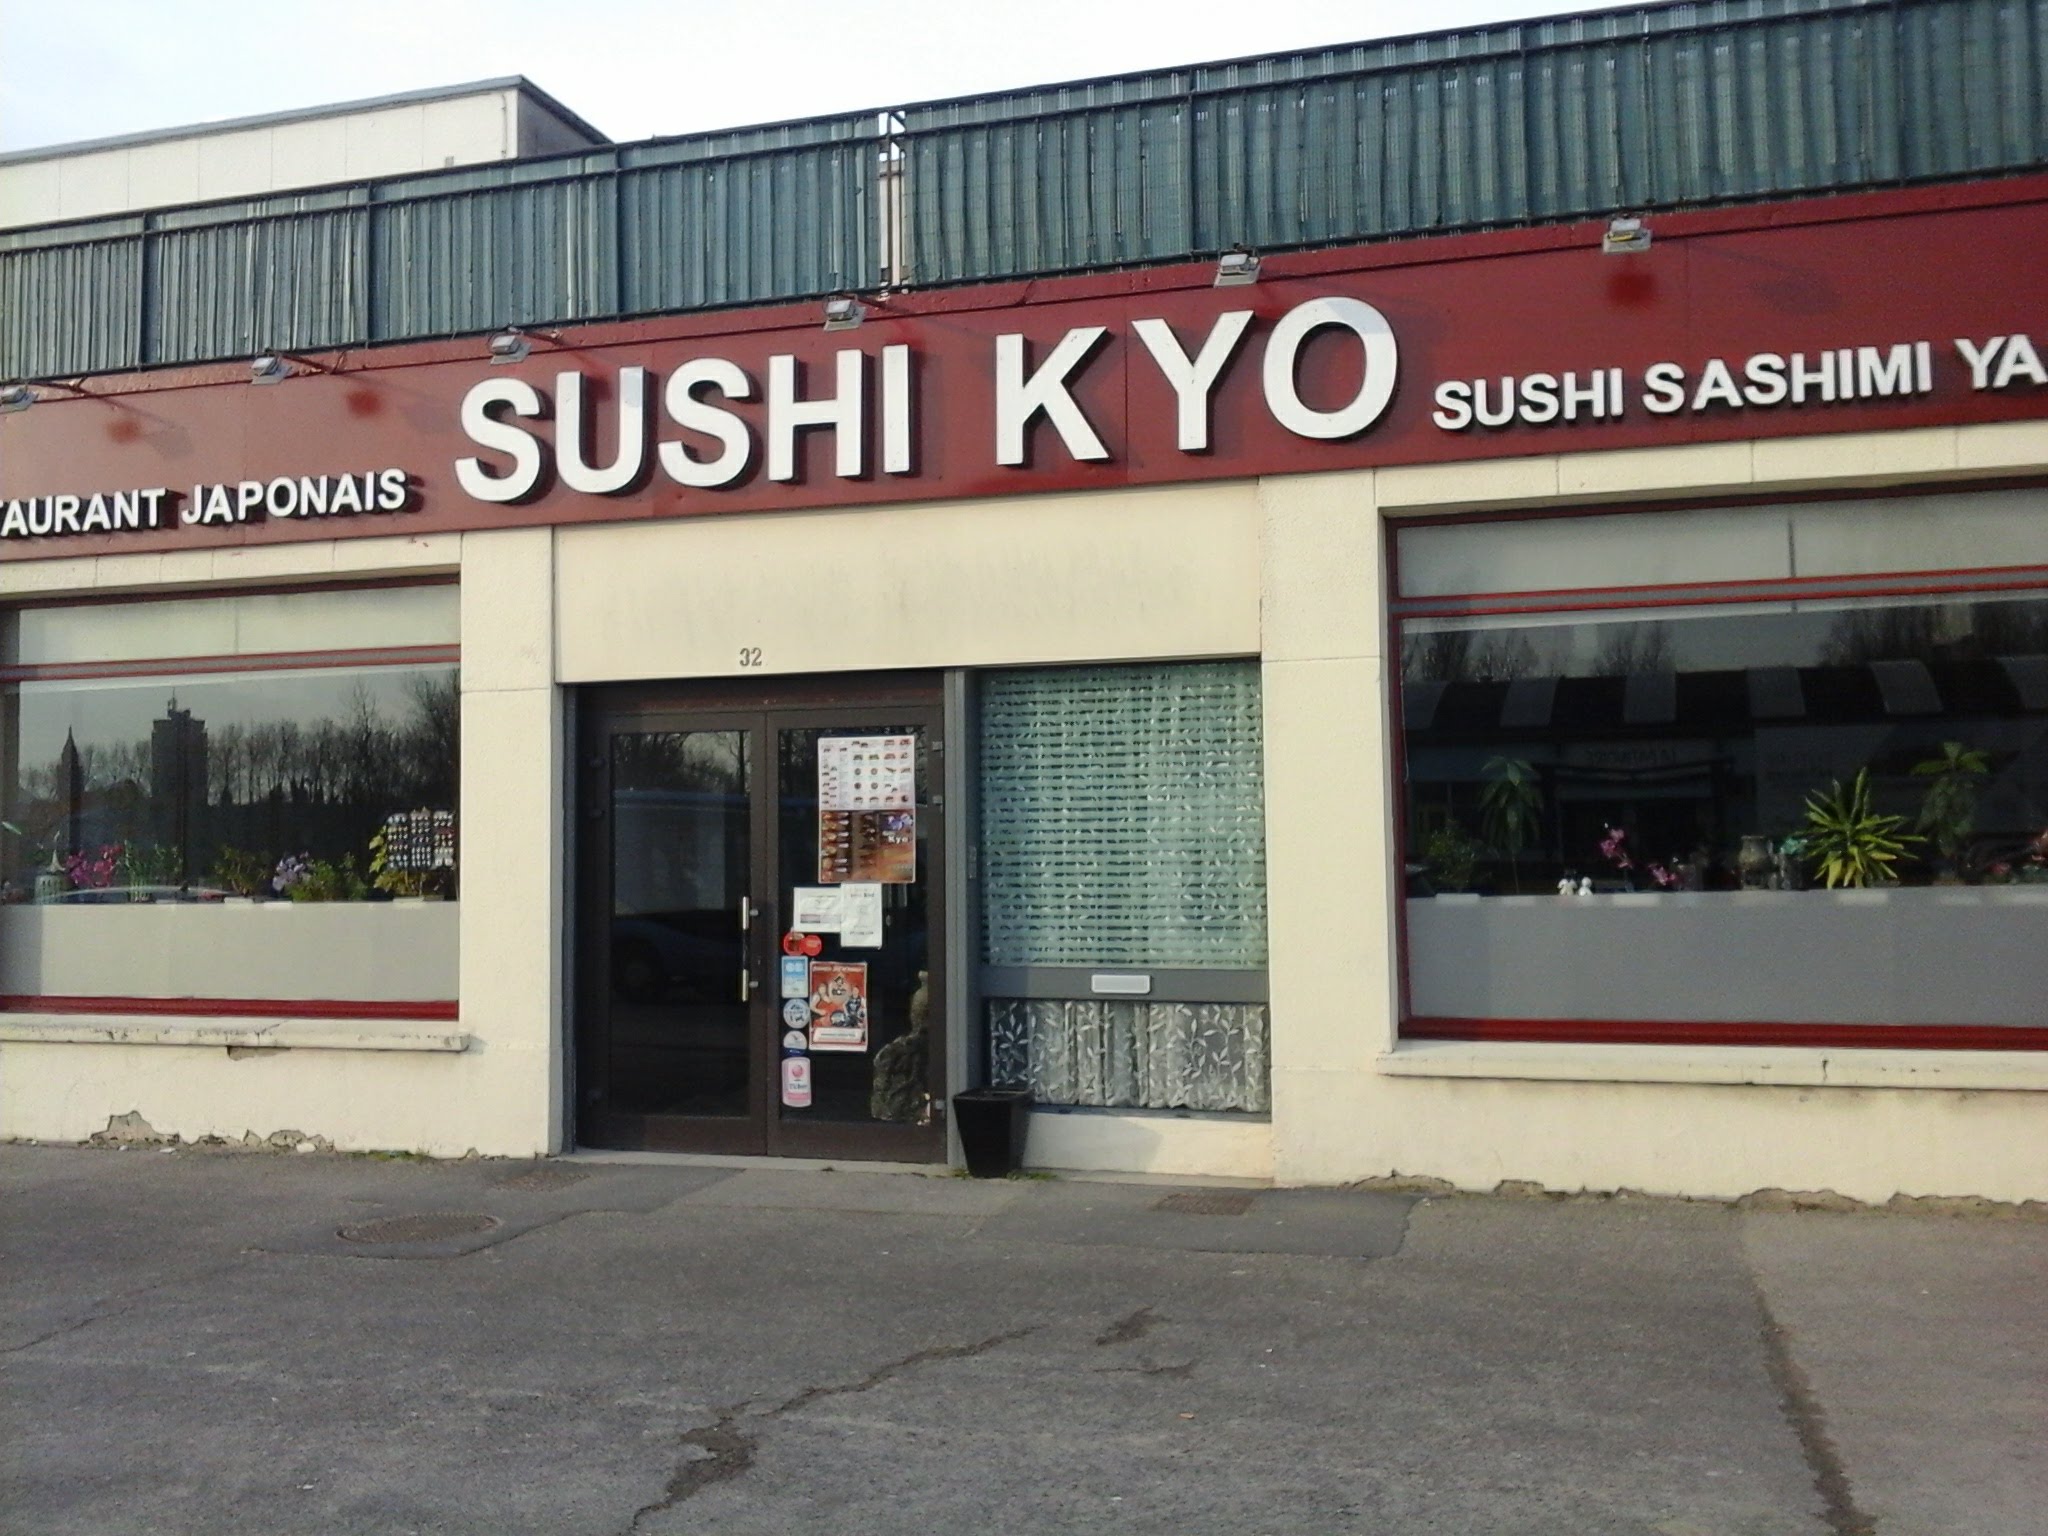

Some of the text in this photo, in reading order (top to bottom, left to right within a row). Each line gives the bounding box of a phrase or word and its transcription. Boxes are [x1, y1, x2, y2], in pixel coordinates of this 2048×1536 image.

[454, 296, 1399, 503] SUSHI KYO
[1432, 334, 2048, 431] SUSHI SASHIMI YA
[0, 468, 407, 537] AURANT JAPONAIS
[739, 647, 762, 667] 32
